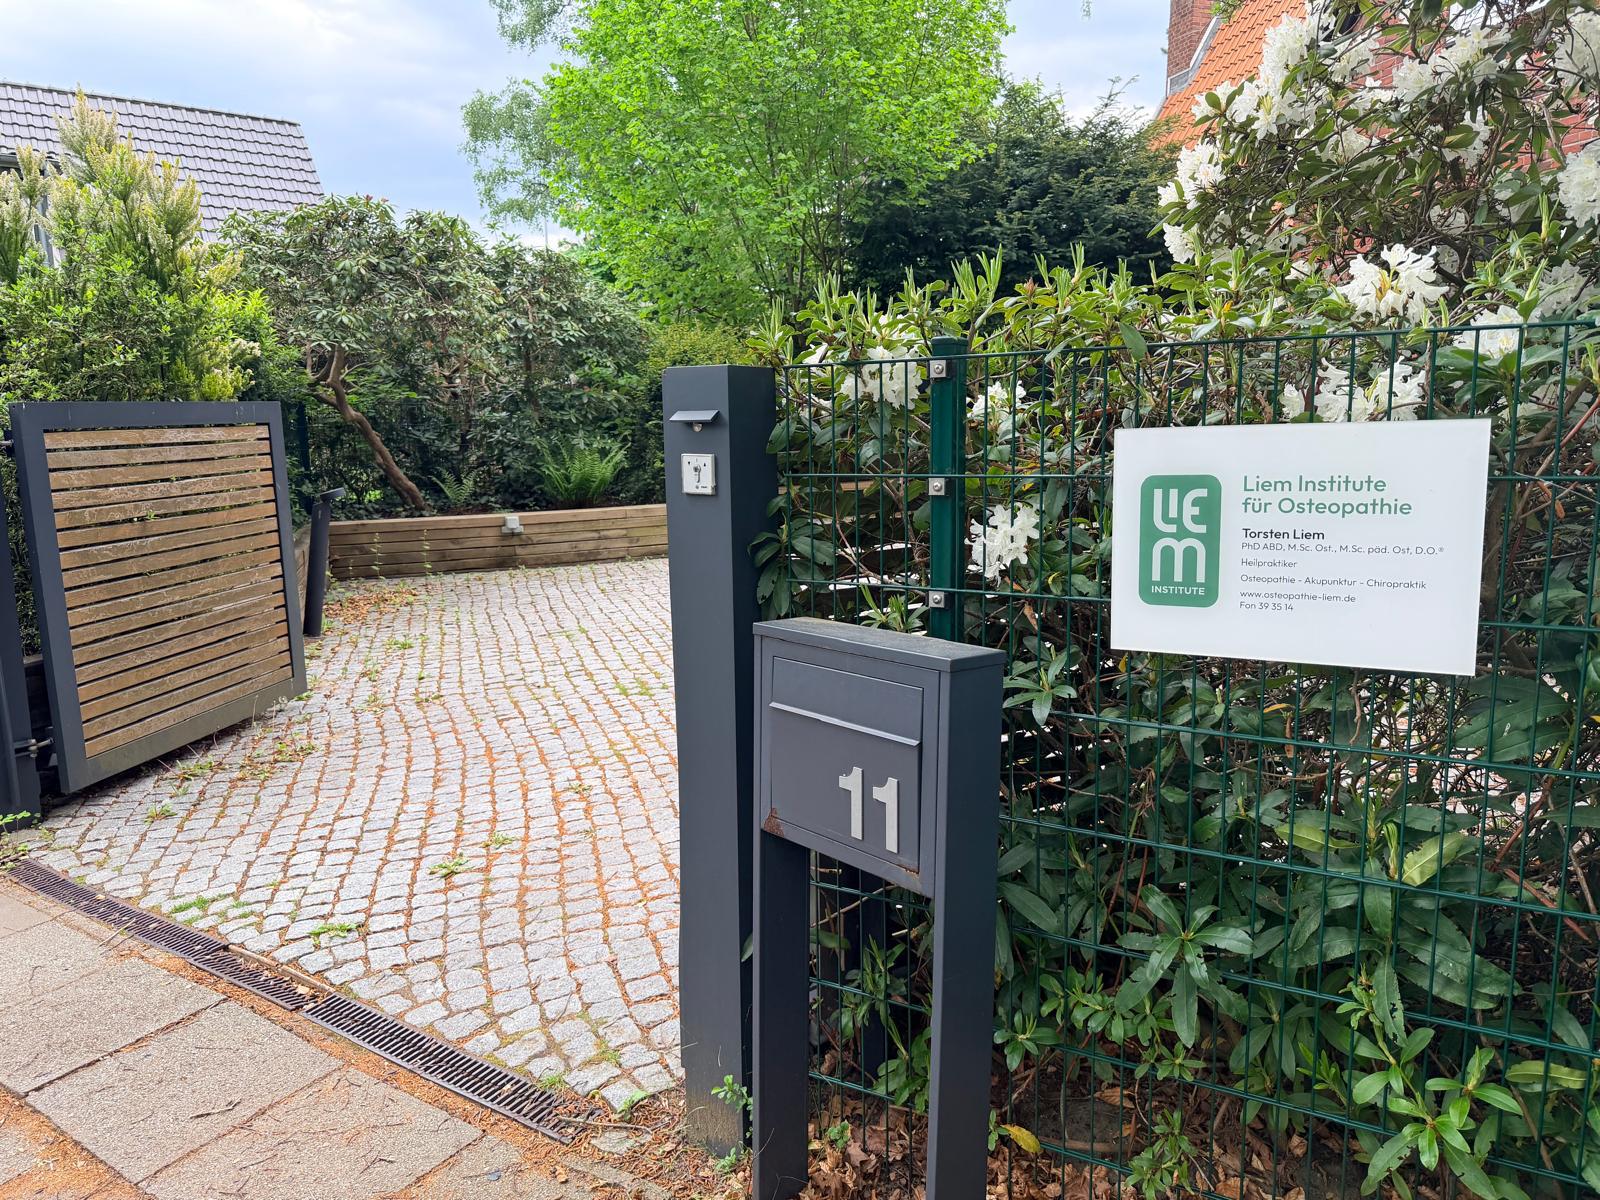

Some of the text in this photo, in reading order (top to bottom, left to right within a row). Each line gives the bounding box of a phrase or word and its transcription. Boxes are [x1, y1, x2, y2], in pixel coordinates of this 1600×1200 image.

[1243, 475, 1387, 492] Liem Institute
[1242, 497, 1413, 518] für Osteopathie
[1242, 528, 1325, 540] Torsten Liem
[1241, 542, 1260, 550] PhD
[1367, 545, 1390, 555] päd.
[1241, 558, 1298, 568] Heilpraktiker
[1240, 574, 1296, 584] Osteopathie
[1304, 576, 1357, 587] Akupunktur
[1366, 578, 1427, 589] Chiropraktik
[1151, 585, 1206, 596] INSTITUTE
[1239, 591, 1356, 603] www.osteopathie-liem.de
[1239, 601, 1294, 611] Fon 39 35 14
[838, 766, 899, 855] 11
